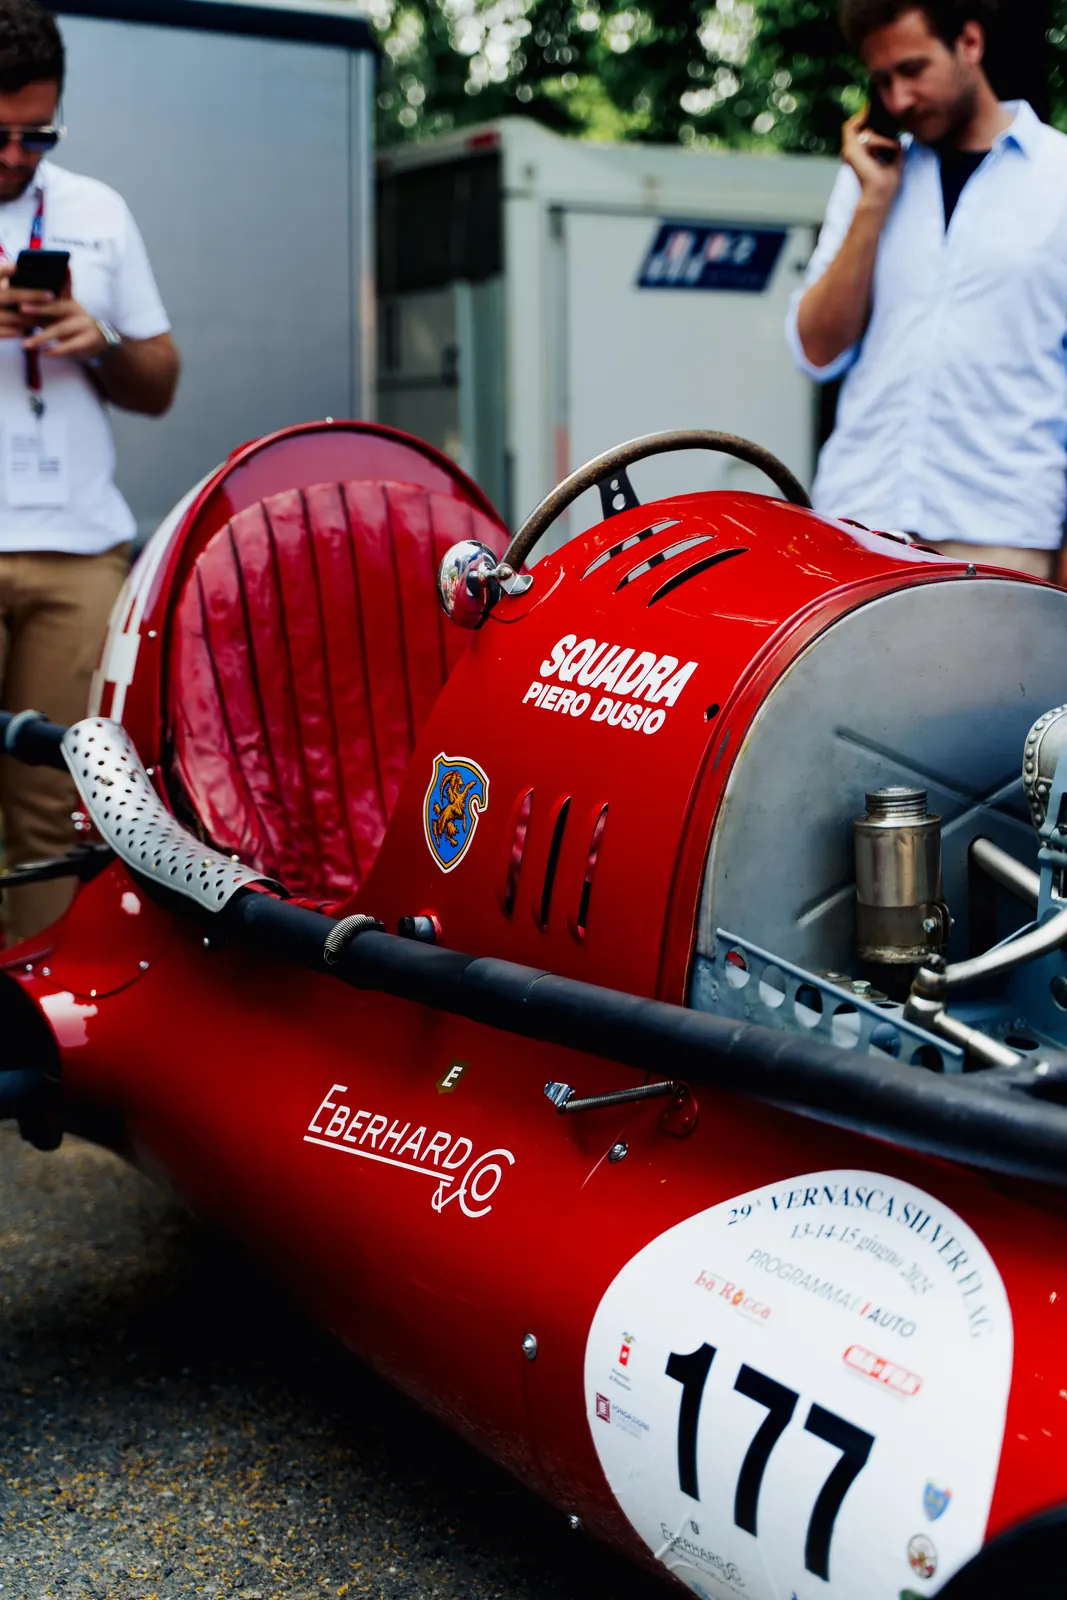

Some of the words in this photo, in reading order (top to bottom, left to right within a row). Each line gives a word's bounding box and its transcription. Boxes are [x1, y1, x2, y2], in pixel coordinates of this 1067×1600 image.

[539, 634, 699, 707] SQUADRA
[522, 681, 591, 717] PIERO
[590, 697, 667, 735] DUSIO
[441, 1065, 463, 1087] E
[307, 1083, 473, 1170] EBERHARD
[771, 1184, 895, 1217] VERNASCA
[896, 1202, 969, 1273] SILVER
[957, 1270, 994, 1340] FLAG
[791, 1222, 861, 1245] 13-14-15
[854, 1234, 904, 1269] giugno
[664, 1342, 876, 1582] 177
